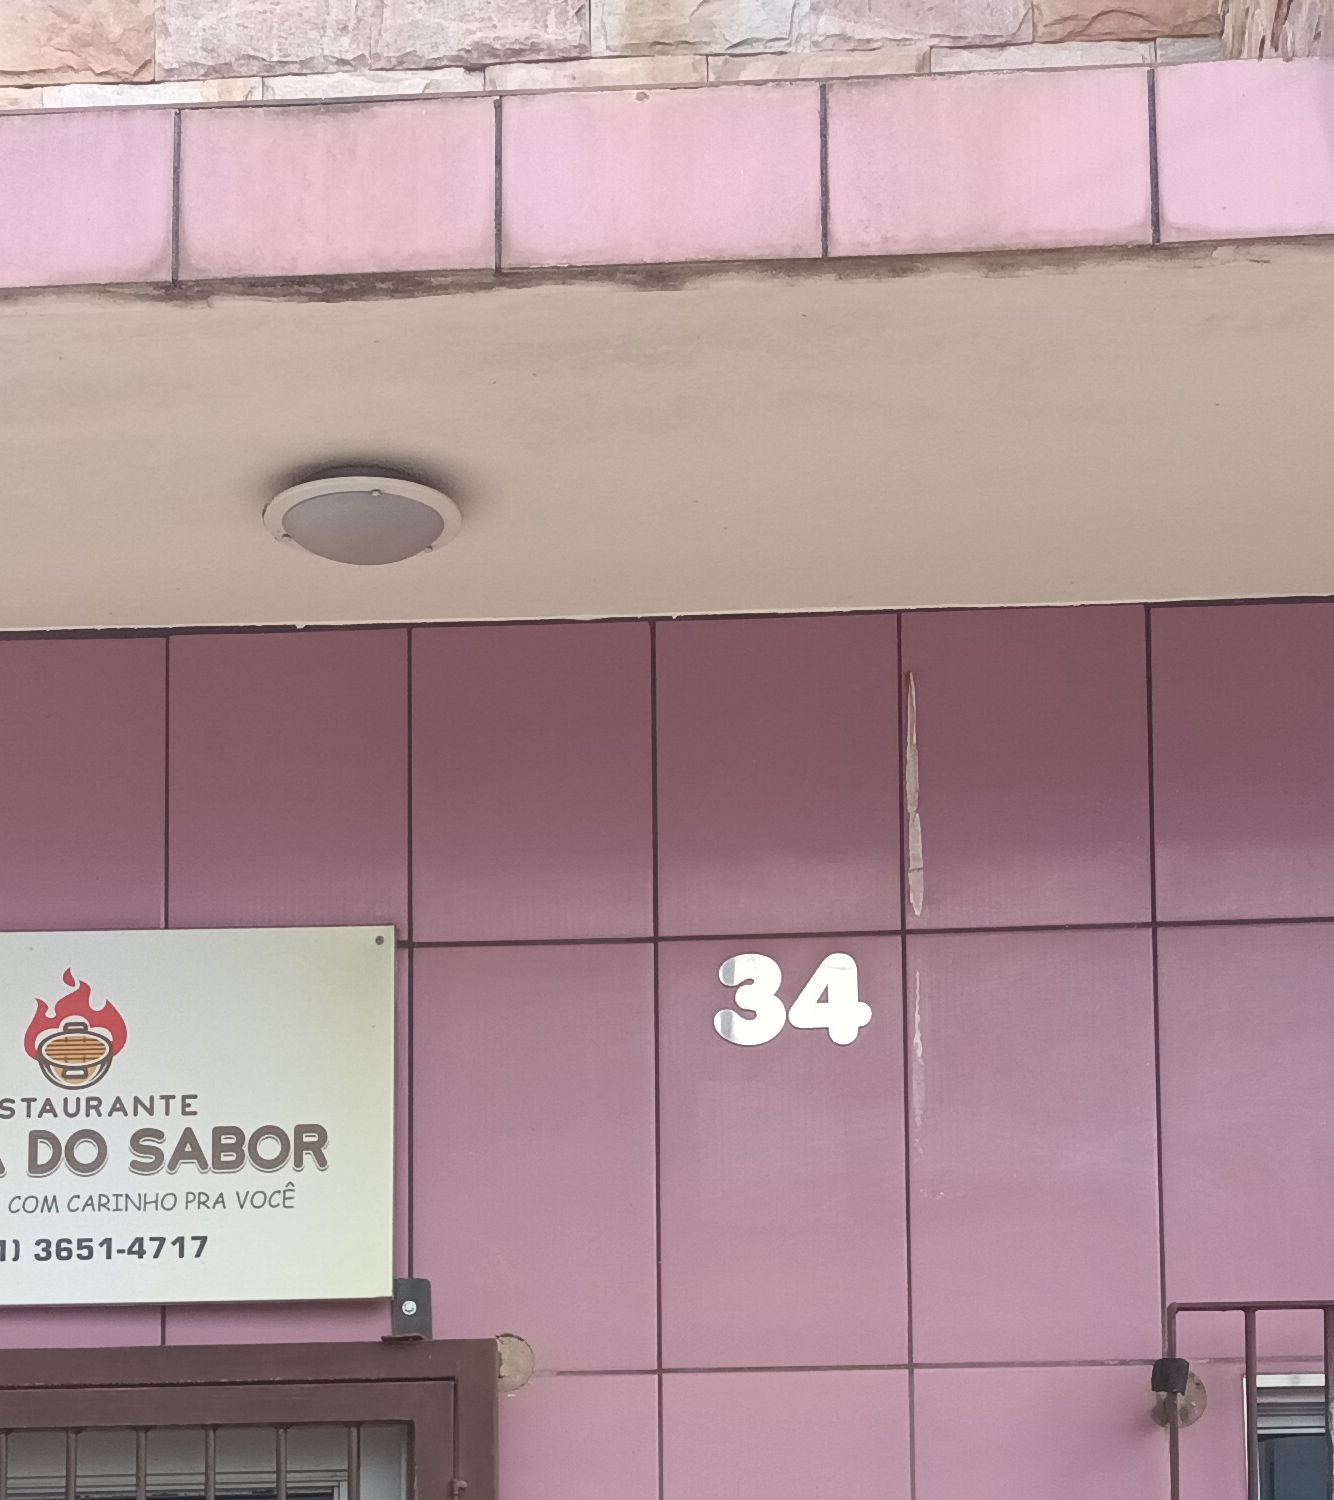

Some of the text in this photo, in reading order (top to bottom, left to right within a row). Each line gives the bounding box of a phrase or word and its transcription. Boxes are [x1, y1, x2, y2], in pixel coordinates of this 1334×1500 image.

[713, 952, 873, 1046] 34
[26, 1128, 109, 1178] DO
[128, 1123, 330, 1176] SABOR
[8, 1194, 60, 1214] COM
[66, 1192, 178, 1213] CARINHO
[184, 1191, 227, 1211] PRA
[235, 1181, 296, 1209] VOCÊ
[33, 1235, 208, 1262] 3651-4717
